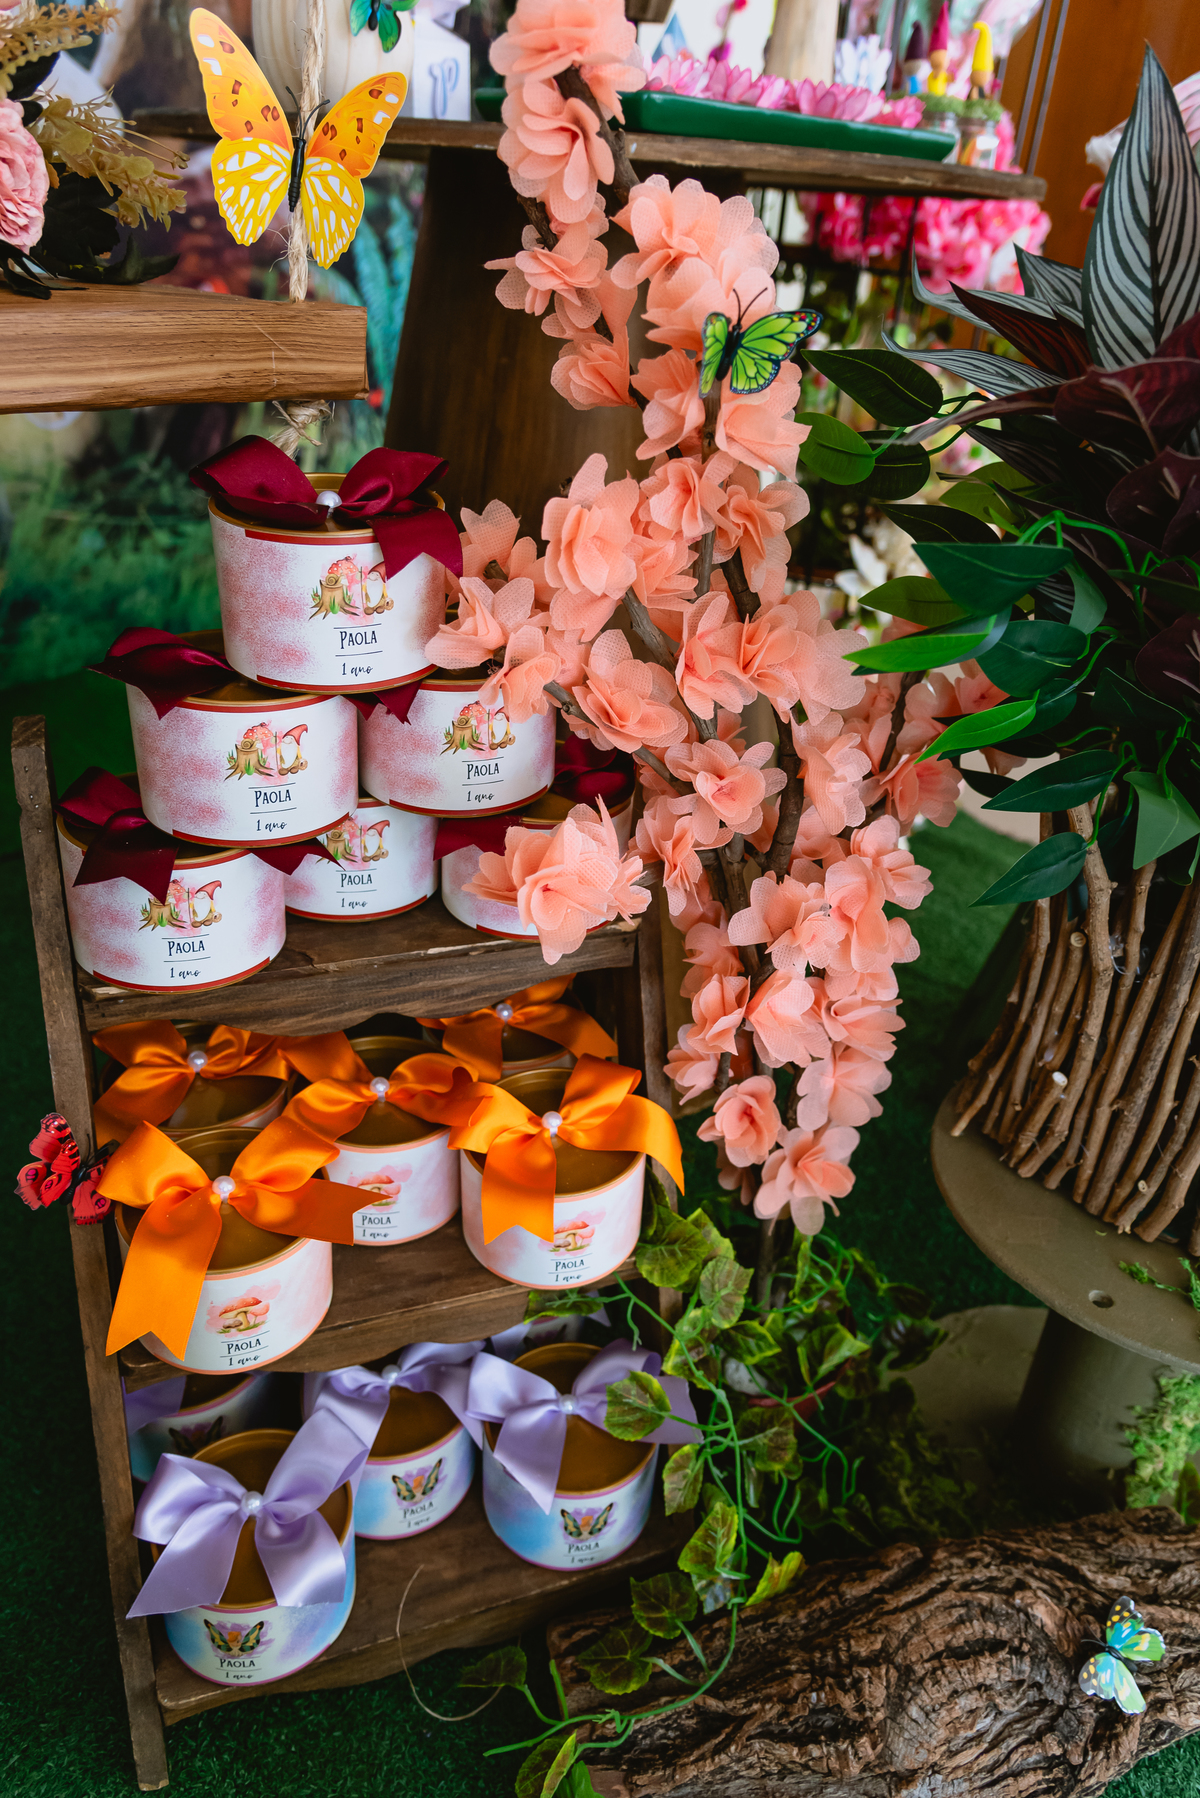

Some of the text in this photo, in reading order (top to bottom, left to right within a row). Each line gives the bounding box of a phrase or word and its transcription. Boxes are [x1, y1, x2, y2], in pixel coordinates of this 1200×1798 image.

[340, 630, 378, 650] PAOLA
[341, 662, 373, 677] 1 ano
[467, 762, 500, 780] PAOLA
[254, 789, 292, 808] PAOLA
[467, 790, 495, 803] 1 ano
[256, 819, 287, 833] 1 ano
[340, 873, 373, 888] PAOLA
[341, 897, 368, 910] 1 ano
[167, 940, 205, 957] PAOLA
[170, 967, 201, 980] 1 ano
[361, 1215, 392, 1226] PAOLA
[555, 1259, 585, 1272] PAOLA
[226, 1338, 262, 1355] PAOLA
[228, 1355, 261, 1366] 1 ano
[219, 1658, 256, 1668] PAOLA
